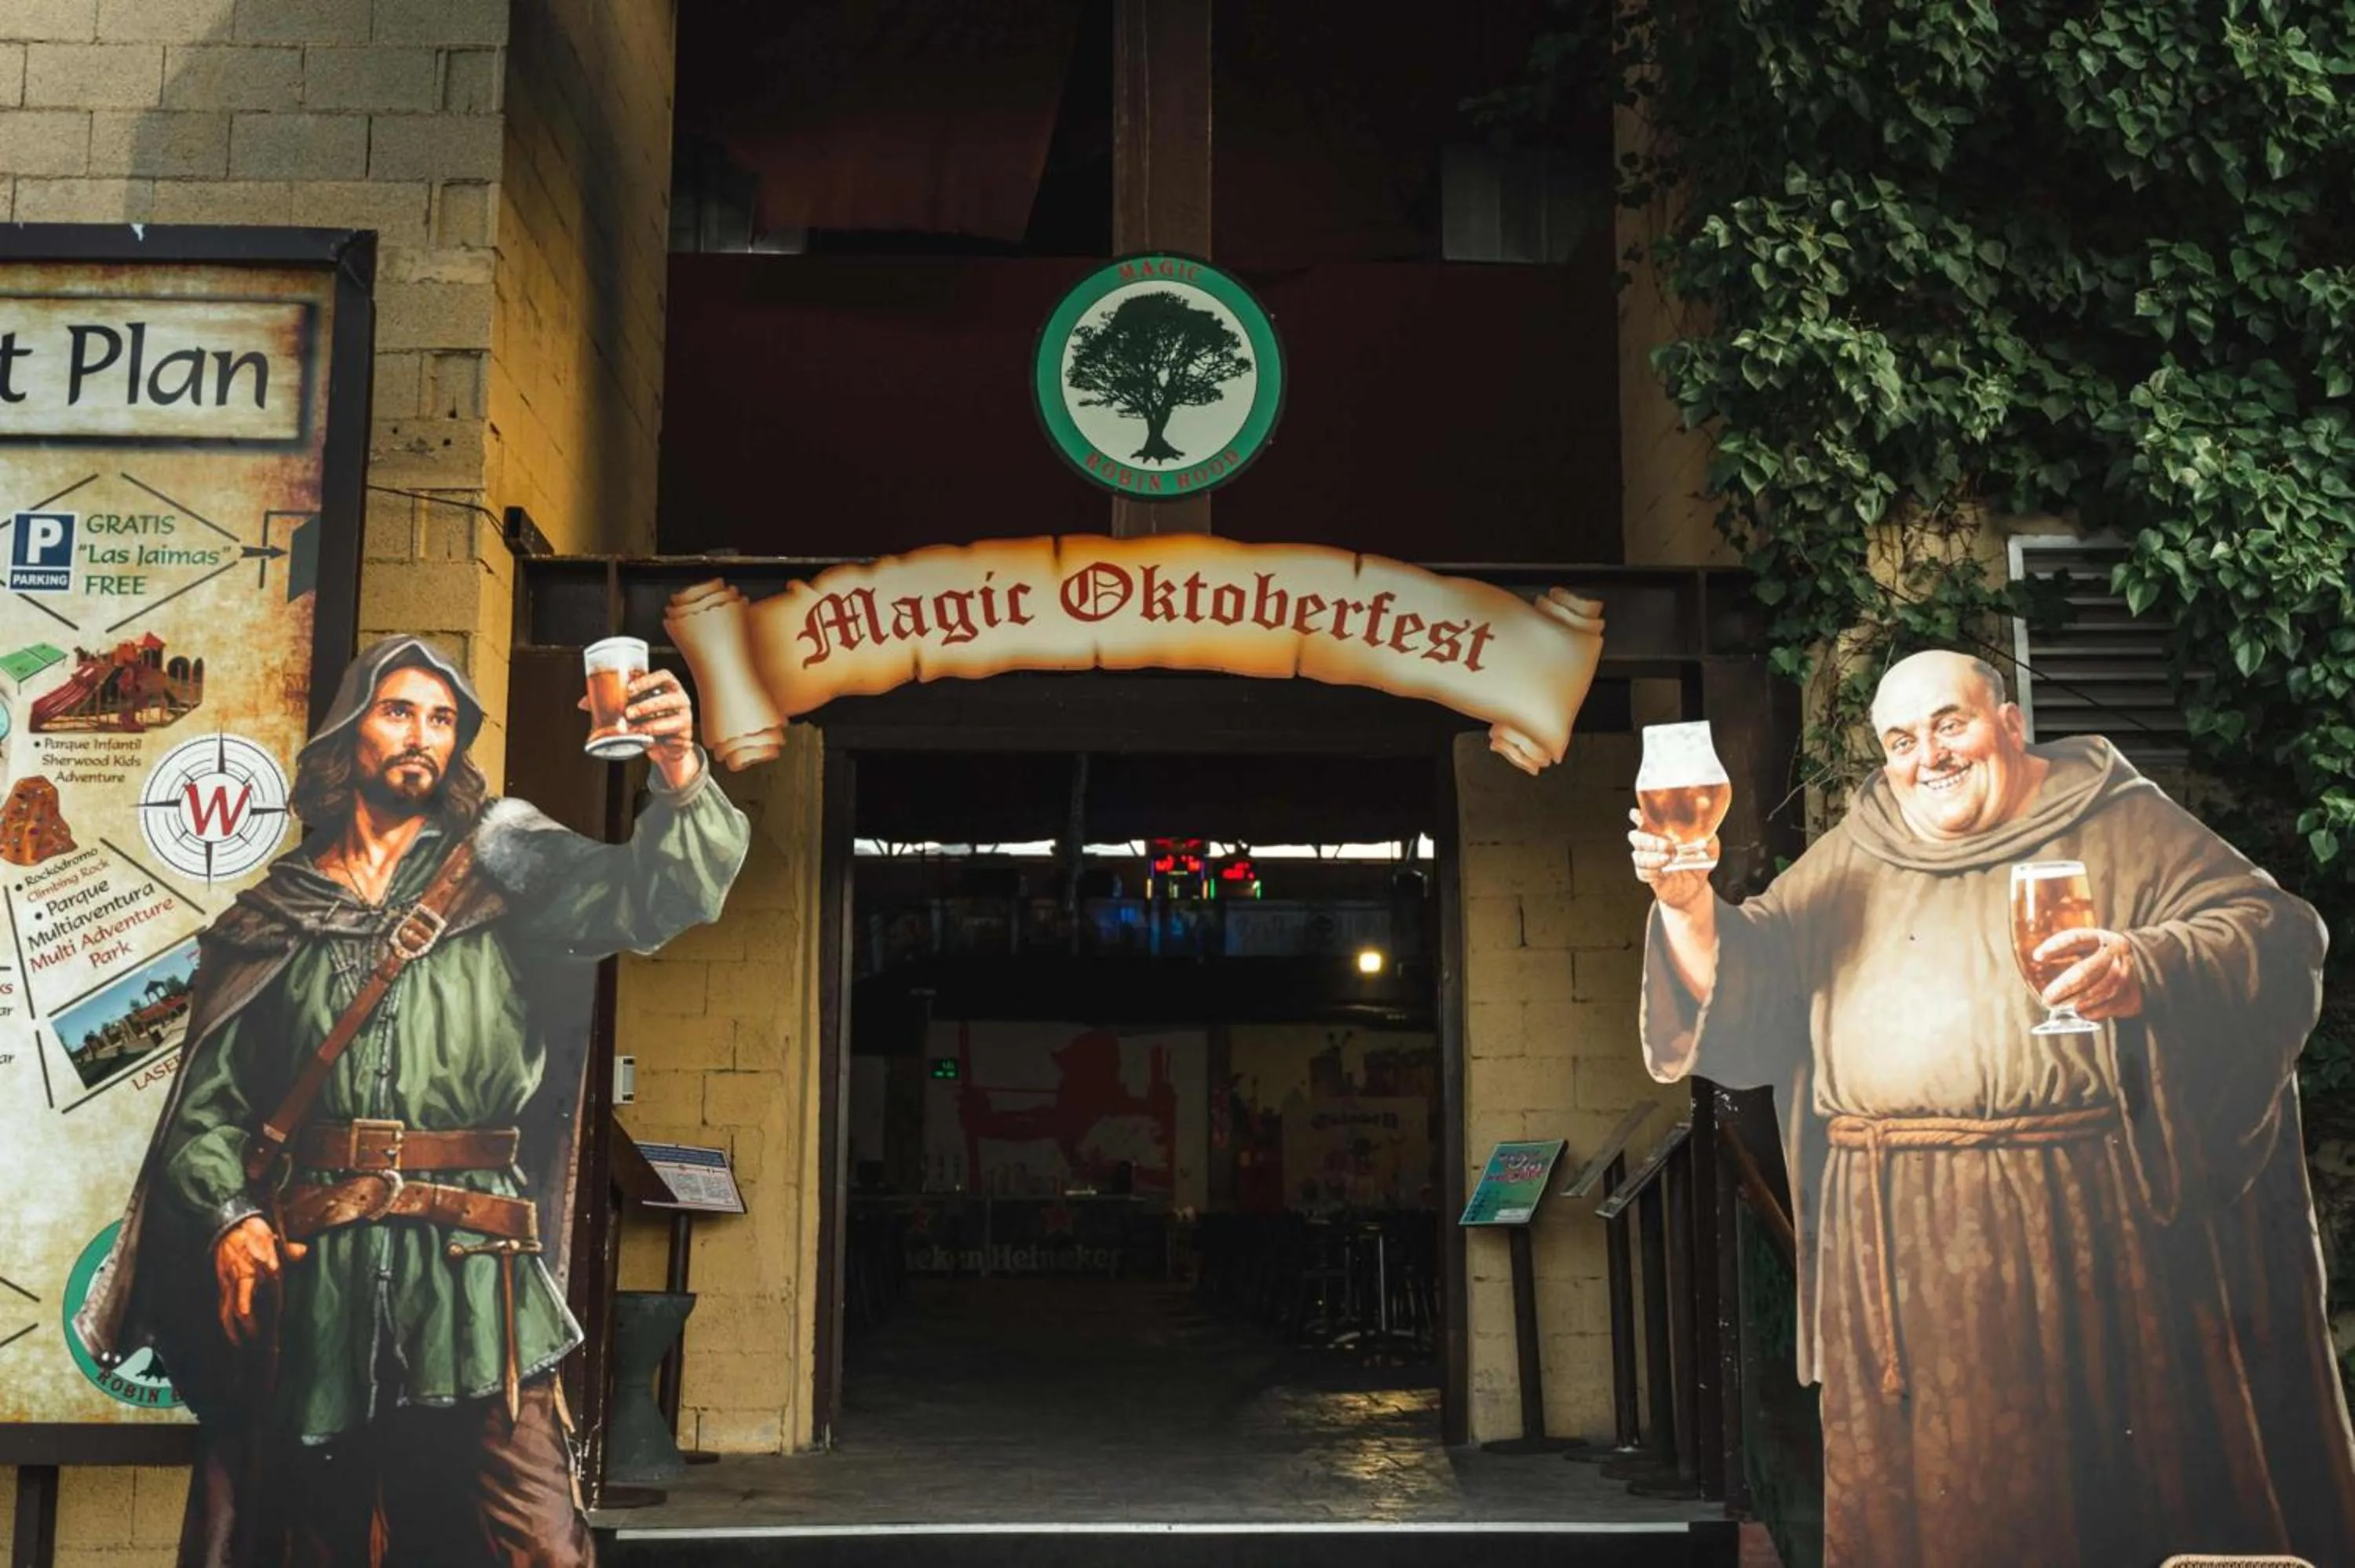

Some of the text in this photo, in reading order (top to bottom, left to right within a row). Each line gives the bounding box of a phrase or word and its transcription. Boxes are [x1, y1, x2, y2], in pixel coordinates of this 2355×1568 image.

[1117, 260, 1200, 280] MAGIC
[66, 322, 269, 409] Plan
[1085, 450, 1241, 490] ROBIN HOOD
[27, 518, 63, 563] P
[86, 514, 176, 534] GRATIS
[12, 573, 68, 586] PARKING
[86, 575, 148, 595] FREE
[795, 560, 1495, 673] Magic Oktoberfest
[42, 754, 142, 766] Sherwood Kids
[44, 737, 143, 752] Parque Infantil
[54, 769, 126, 783] Adventure
[184, 781, 254, 837] W
[46, 879, 110, 917] Parque
[27, 882, 155, 951] Multiaventura
[29, 898, 175, 972] Multi Adventure
[89, 941, 133, 969] Park
